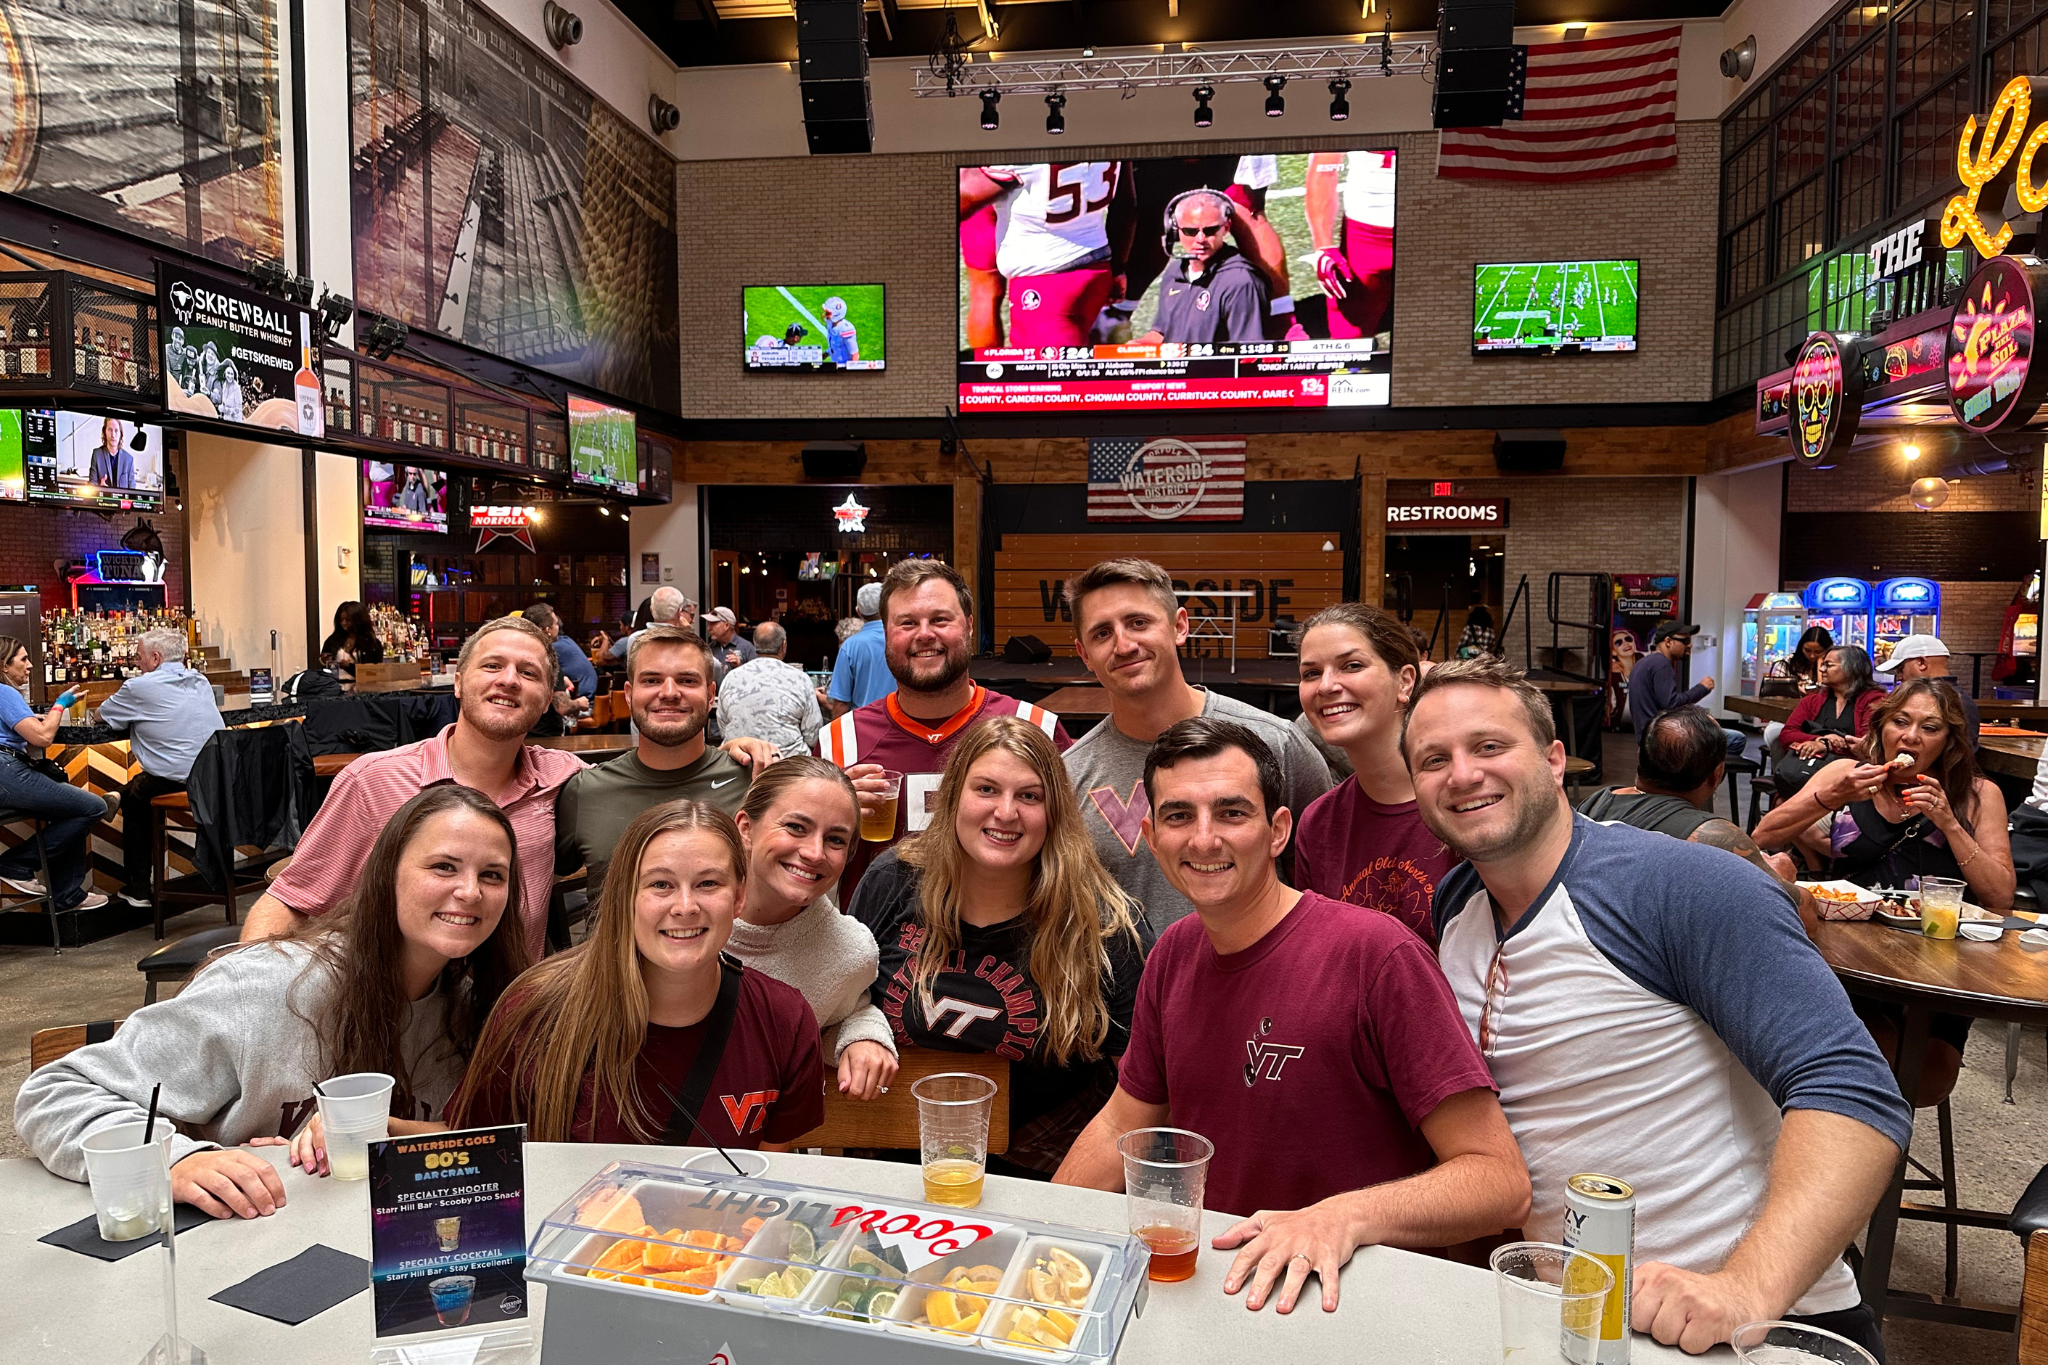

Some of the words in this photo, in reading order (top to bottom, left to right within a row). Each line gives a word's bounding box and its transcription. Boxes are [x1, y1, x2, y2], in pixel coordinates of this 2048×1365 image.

[1316, 163, 1345, 173] ESPN
[1869, 218, 1926, 283] THE
[194, 288, 293, 336] SKREWBALL
[196, 312, 228, 331] PEANUT
[229, 321, 259, 339] BUTTER
[260, 329, 293, 347] WHISKEY
[1978, 305, 2028, 354] PLAZA
[1117, 345, 1157, 354] CLEMSON
[1190, 343, 1214, 357] 24
[1335, 342, 1343, 350] &
[1344, 342, 1351, 350] 6
[1995, 334, 2011, 350] DEL
[231, 345, 294, 371] #GETSKREWED
[990, 348, 1024, 356] FLORIDA
[1066, 346, 1090, 360] 24
[1990, 341, 2018, 370] SOL
[1105, 361, 1135, 369] Alabama
[1257, 363, 1290, 371] TONIGHT
[972, 385, 1004, 393] TROPICAL
[1005, 385, 1028, 393] STORM
[1029, 384, 1062, 392] WARNING
[1131, 383, 1165, 391] NEWPORT
[1166, 382, 1187, 390] NEWS
[1994, 366, 2021, 403] TACOS
[965, 395, 1004, 405] COUNTY,
[1006, 394, 1044, 404] CAMDEN
[1044, 393, 1084, 403] COUNTY,
[1087, 392, 1124, 402] CHOWAN
[1126, 391, 1166, 402] COUNTY,
[1168, 390, 1219, 401] CURRITUCK
[1221, 390, 1262, 400] COUNTY,
[1263, 389, 1287, 399] DARE
[1964, 385, 1992, 423] STREET
[1119, 460, 1214, 492] WATERSIDE
[1145, 482, 1190, 499] DISTRICT
[1434, 482, 1452, 496] EXIT
[475, 516, 526, 525] NORFOLK
[1387, 505, 1498, 522] RESTROOMS
[102, 555, 141, 565] WICKED
[103, 564, 141, 578] TUNA
[1620, 600, 1652, 609] PIXEL
[1652, 600, 1671, 609] PIX
[927, 733, 943, 742] VT
[1087, 778, 1152, 857] V
[1375, 856, 1397, 871] Old
[1397, 858, 1429, 885] North
[920, 990, 1004, 1039] VT
[974, 954, 1038, 1062] CHAMPIO
[1246, 1040, 1305, 1080] VT
[719, 1089, 780, 1137] VT
[397, 1138, 464, 1154] WATERSIDE
[465, 1134, 497, 1147] GOES
[425, 1151, 470, 1170] 80'S
[414, 1172, 439, 1182] BAR
[440, 1166, 481, 1179] CRAWL
[397, 1188, 450, 1203] SPECIALTY
[452, 1182, 499, 1196] SHOOTER
[376, 1206, 399, 1215] Starr
[400, 1202, 415, 1212] Hill
[417, 1201, 432, 1210] Bar
[439, 1196, 473, 1208] Scooby
[474, 1193, 493, 1202] Doo
[494, 1190, 521, 1200] Snack
[688, 1189, 833, 1222] LIGHT
[829, 1205, 994, 1257] Coors
[399, 1255, 451, 1269] SPECIALTY
[453, 1248, 503, 1261] COCKTAIL
[386, 1273, 409, 1282] Starr
[410, 1269, 425, 1278] Hill
[427, 1266, 443, 1276] Bar
[450, 1264, 469, 1274] Stay
[470, 1257, 514, 1270] Excellent!
[499, 1299, 523, 1309] WATERSIDE
